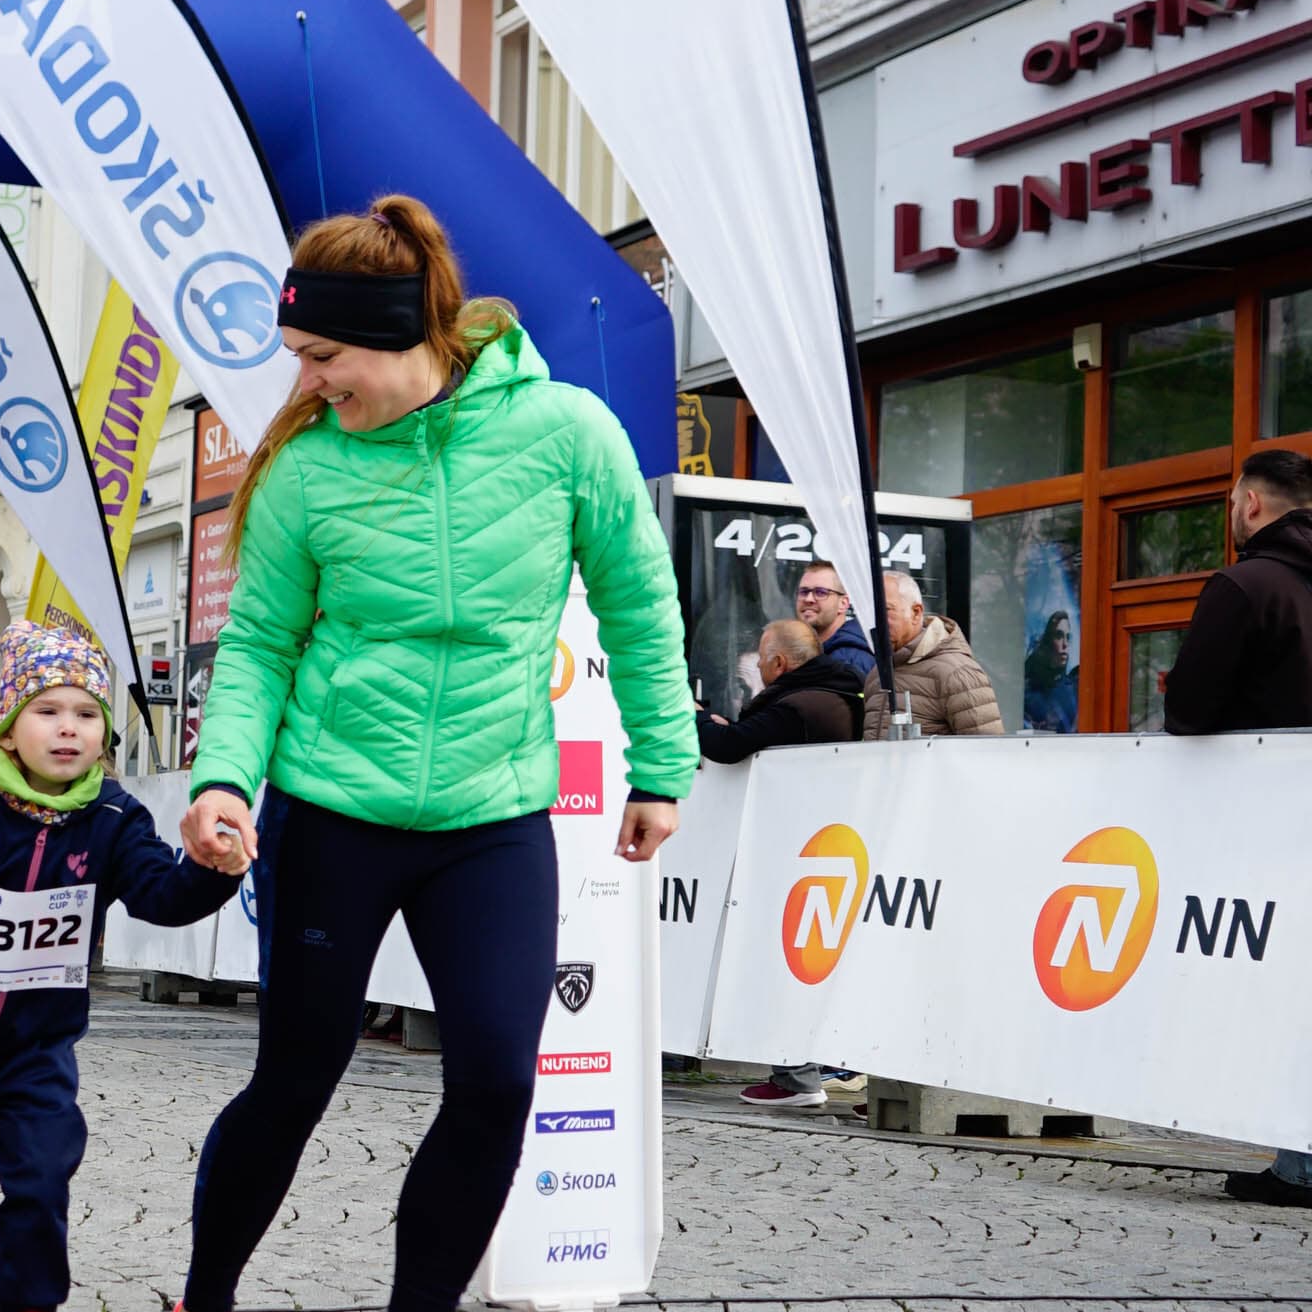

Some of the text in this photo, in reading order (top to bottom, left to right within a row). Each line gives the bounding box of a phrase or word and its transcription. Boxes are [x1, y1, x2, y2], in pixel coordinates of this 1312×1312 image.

[894, 77, 1312, 273] LUNETT
[714, 519, 927, 571] 4/24
[587, 658, 610, 678] N
[591, 880, 620, 888] Powered
[591, 889, 600, 897] by
[49, 902, 68, 910] CUP
[863, 874, 942, 930] NN
[1176, 895, 1276, 962] NN
[541, 1057, 609, 1072] NUTREND
[561, 1172, 617, 1191] ŠKODA
[546, 1242, 608, 1263] KPMG
